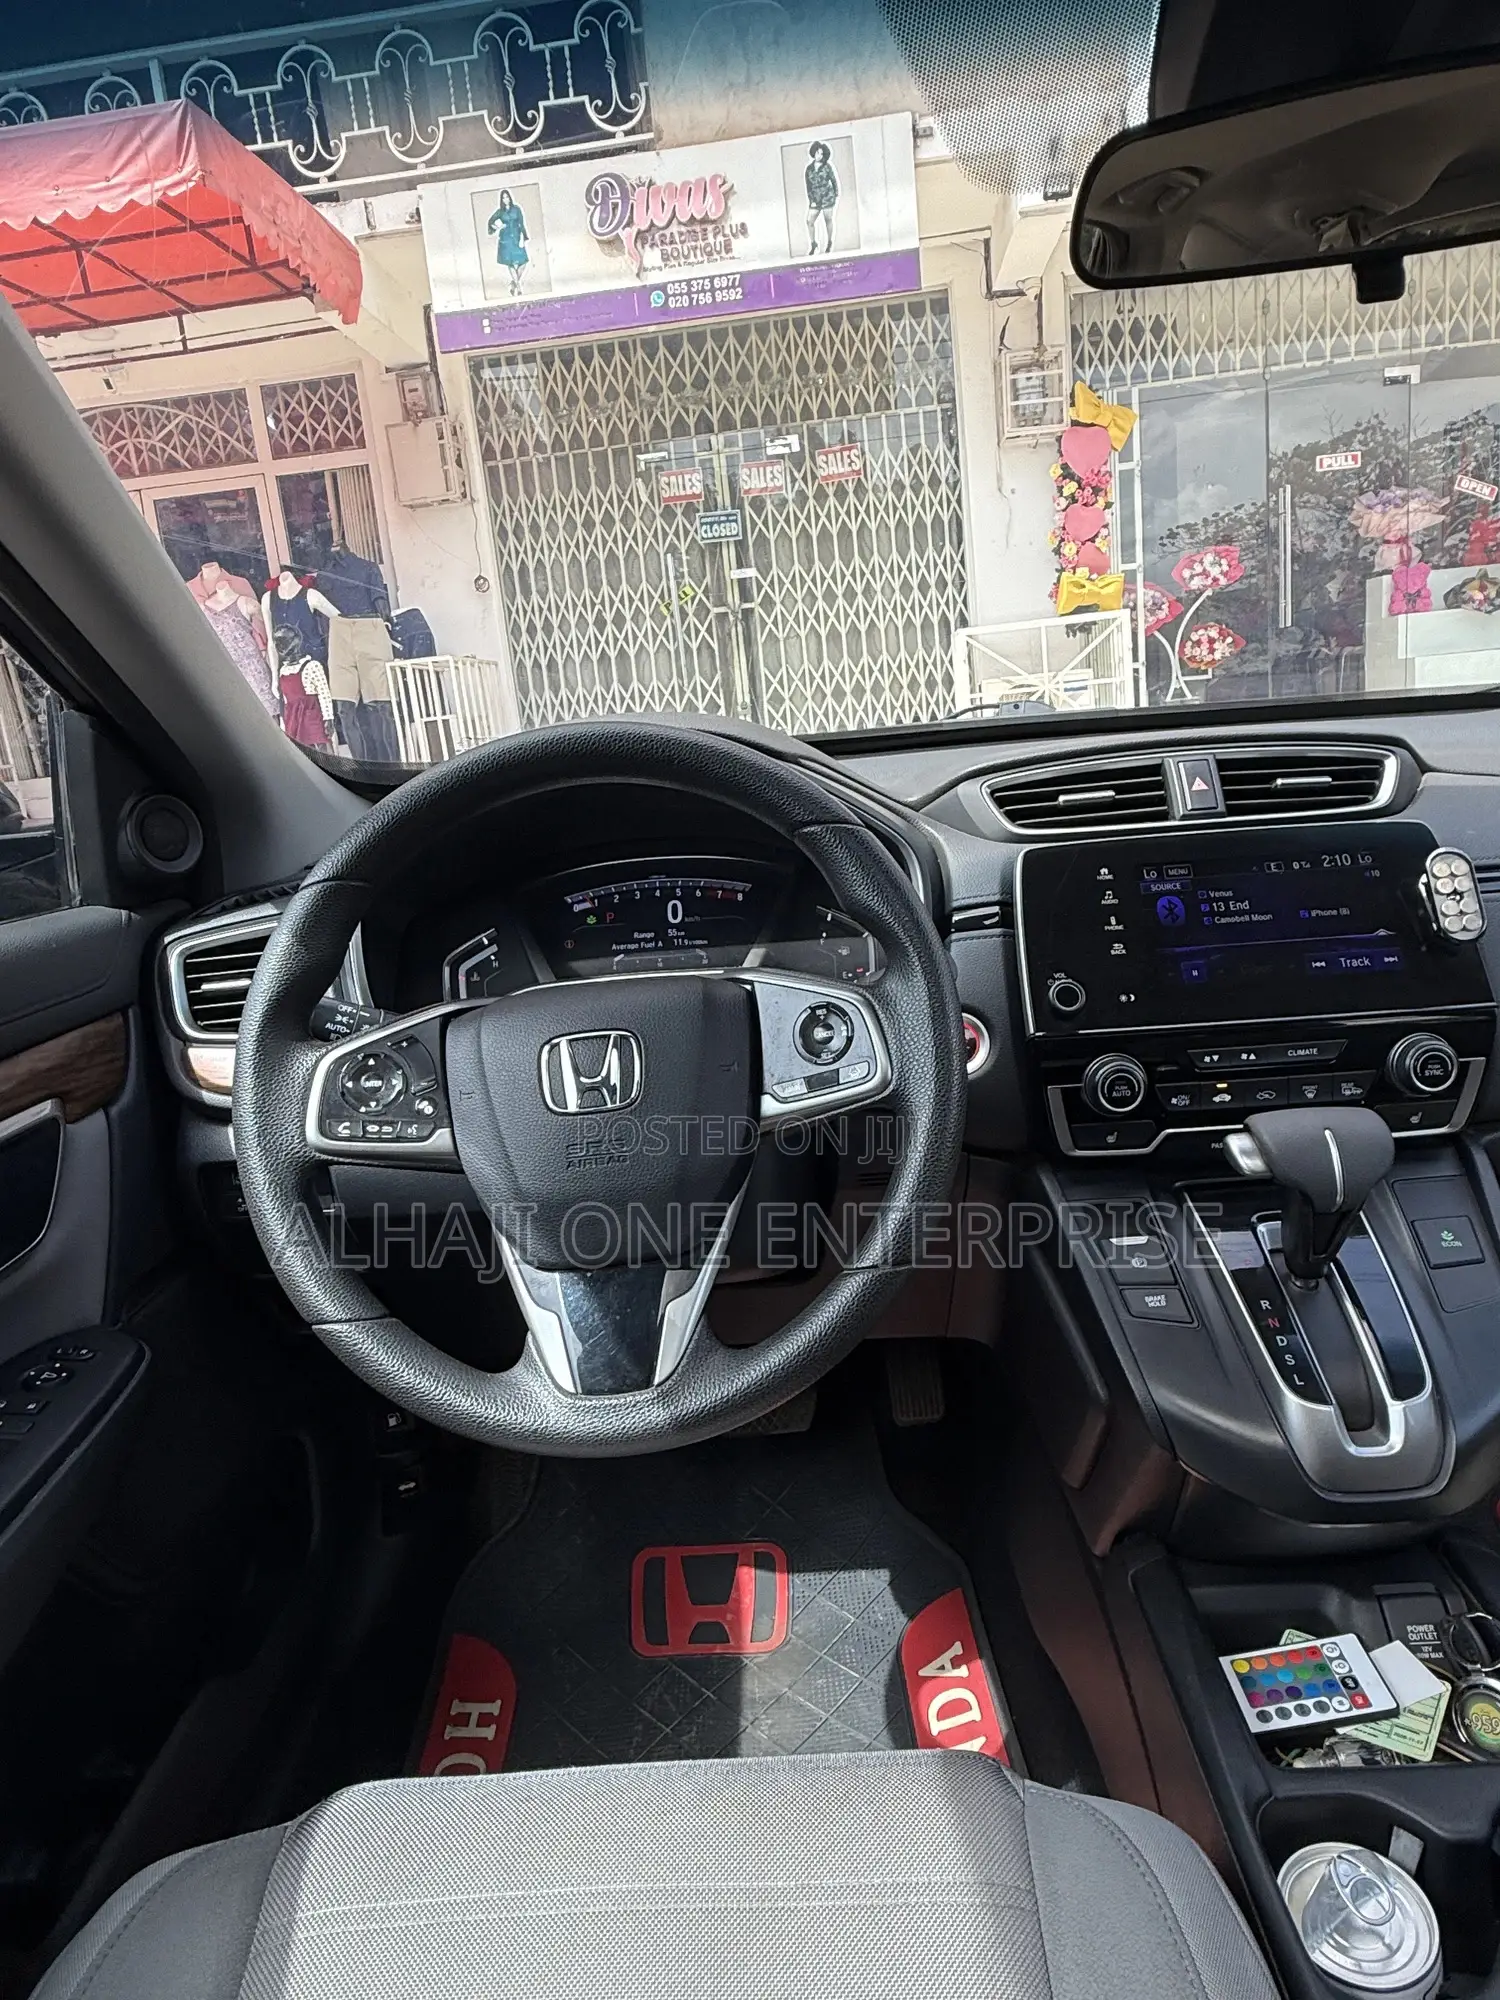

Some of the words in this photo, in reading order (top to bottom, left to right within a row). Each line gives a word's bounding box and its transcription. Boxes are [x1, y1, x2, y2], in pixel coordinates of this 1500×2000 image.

[585, 172, 734, 239] Divas
[712, 222, 749, 240] PLUS
[660, 239, 733, 263] BOUTIQUE
[667, 282, 688, 295] 055
[691, 279, 711, 291] 375
[714, 274, 741, 288] 6977
[668, 295, 689, 308] 020
[691, 292, 712, 305] 756
[715, 287, 743, 302] 9592
[819, 449, 861, 477] SALES
[1322, 455, 1355, 468] PULL
[741, 465, 782, 490] SALES
[661, 474, 702, 498] SALES
[1460, 477, 1491, 496] OPEN
[701, 522, 738, 538] CLOSED
[1322, 853, 1351, 867] 2:10
[1168, 867, 1189, 876] MENU
[1150, 882, 1181, 891] SOURCE
[1209, 890, 1234, 898] Venus
[1212, 902, 1226, 912] 13
[1229, 900, 1250, 911] End
[1251, 913, 1273, 921] Moon
[1311, 909, 1338, 917] iPhone
[612, 943, 639, 951] Average
[1339, 956, 1371, 968] Track
[338, 1004, 353, 1014] OFF
[325, 1023, 346, 1033] AUTO
[1287, 1048, 1318, 1057] CLIMATE
[1145, 1294, 1166, 1302] BRAKE
[1260, 1300, 1271, 1310] R
[1267, 1318, 1280, 1328] N
[1275, 1336, 1288, 1346] D
[1285, 1354, 1295, 1365] S
[1293, 1374, 1304, 1385] L
[1407, 1624, 1435, 1633] POWER
[1408, 1632, 1438, 1641] OUTLET
